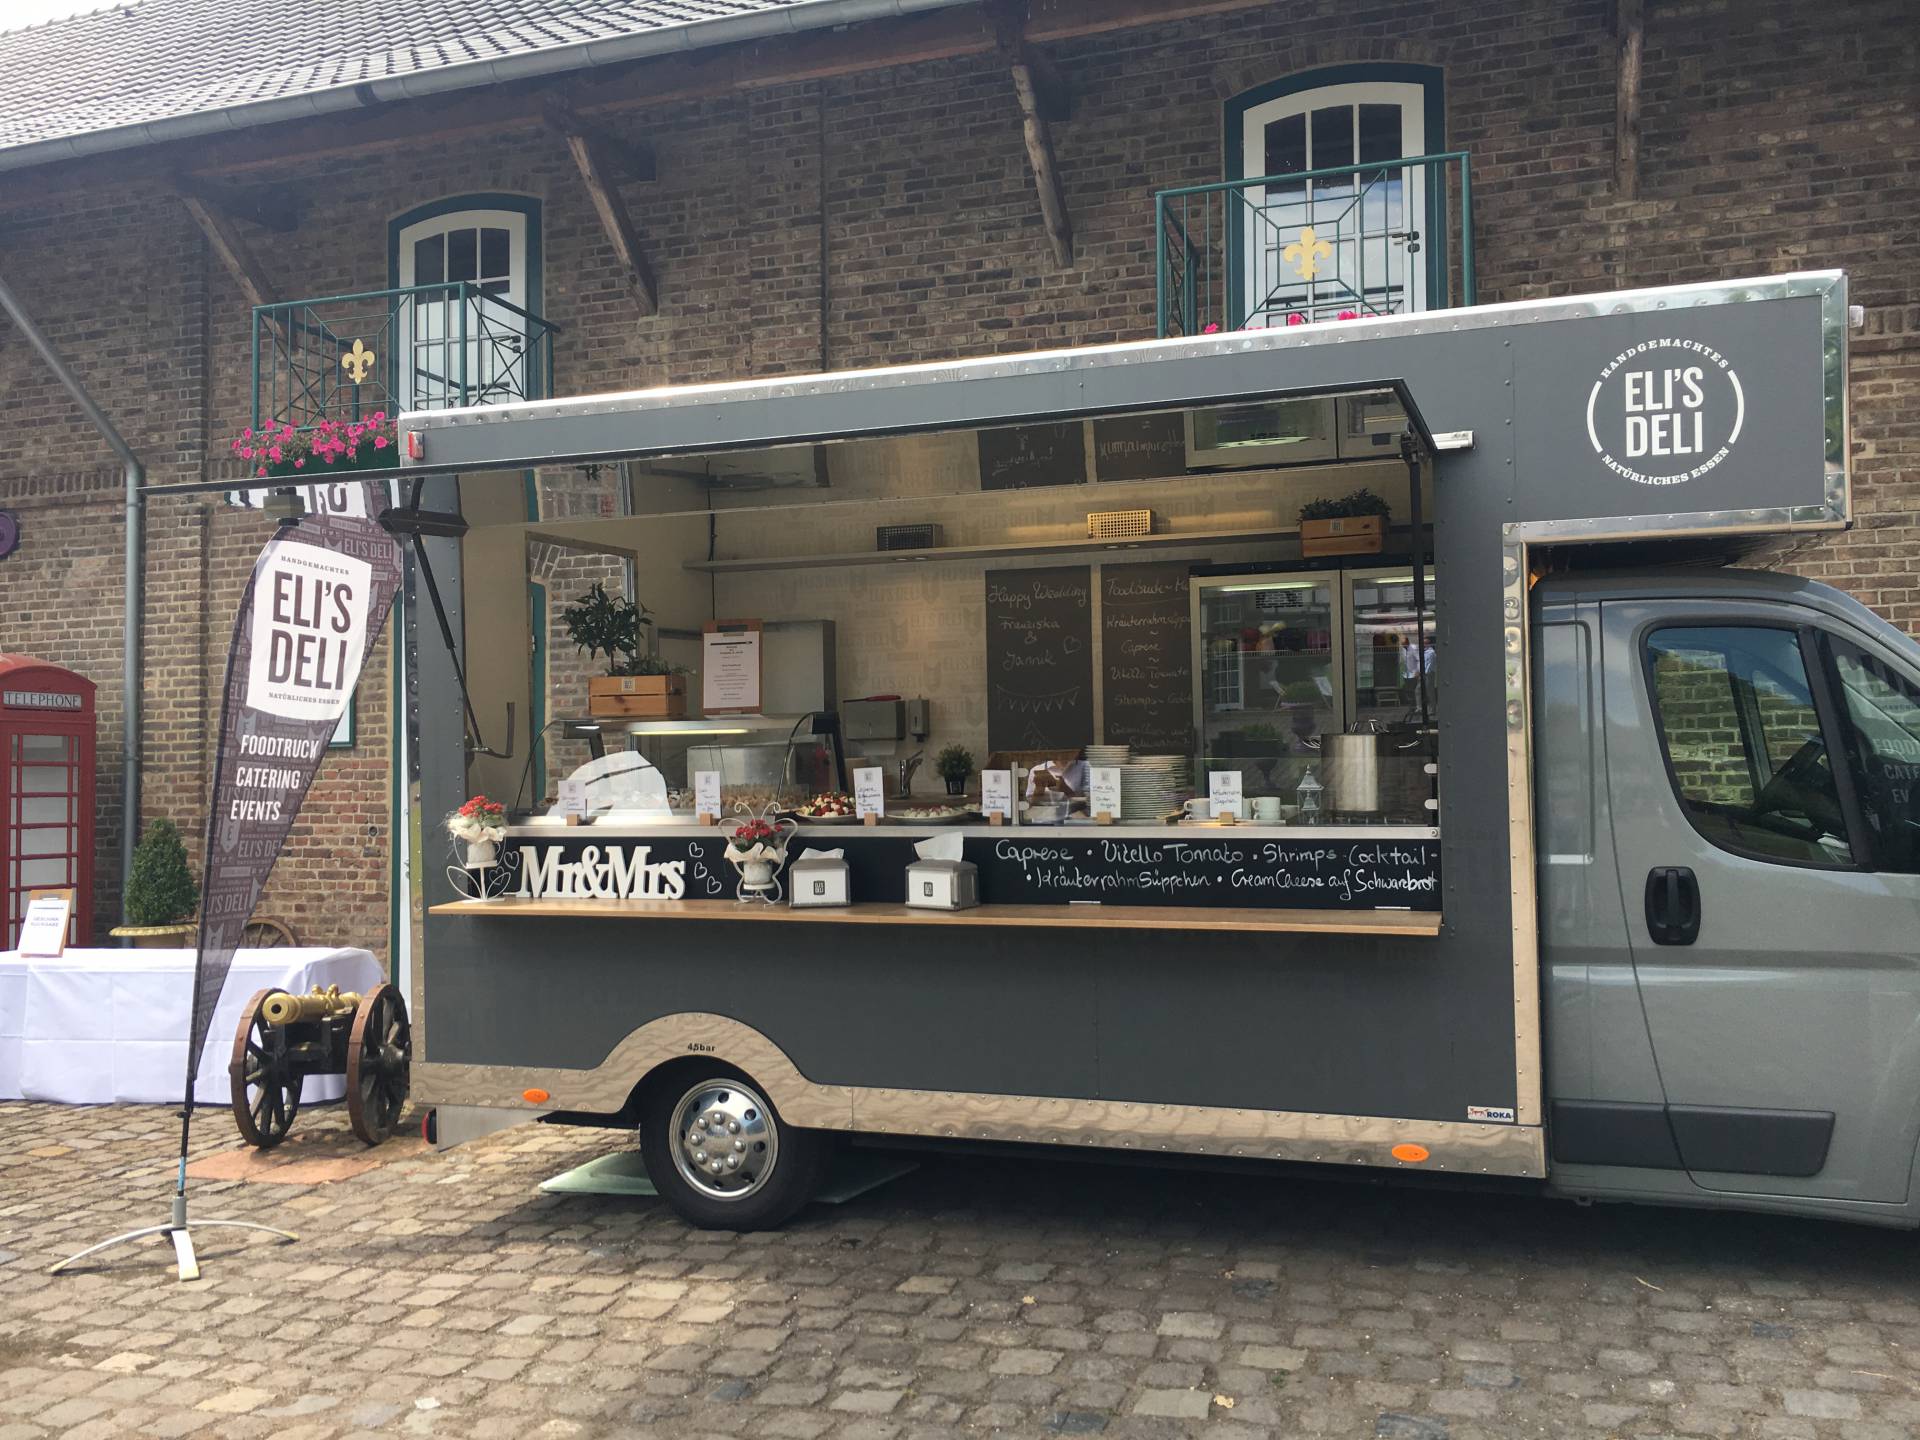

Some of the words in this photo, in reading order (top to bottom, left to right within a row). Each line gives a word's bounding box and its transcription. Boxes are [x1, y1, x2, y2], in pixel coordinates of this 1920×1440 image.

[1600, 338, 1729, 378] HANDGEMACHTES
[1625, 366, 1704, 413] ELI'S
[1625, 411, 1703, 458] DELI
[1601, 453, 1690, 486] NATÜRLICHES
[1690, 446, 1730, 479] ESSEN
[281, 555, 350, 576] HANDGEMACHTES
[370, 542, 393, 560] DELI
[272, 570, 353, 634] ELI'S
[987, 583, 1032, 610] Happy
[1032, 581, 1088, 608] Wedding
[267, 628, 348, 690] DELI
[5, 692, 79, 708] TELEPHONE
[268, 691, 317, 705] NATÜRLICHES
[318, 697, 340, 706] ESSEN
[240, 734, 320, 761] FOODTRUCK
[235, 766, 301, 790] CATERING
[230, 799, 282, 822] EVENTS
[995, 839, 1074, 870] Caprese
[1100, 840, 1163, 865] Vitello
[1163, 842, 1244, 865] Tonnato
[1262, 843, 1338, 872] Shrimps
[516, 845, 686, 900] Mr&Mrs
[1328, 868, 1351, 901] auf
[1486, 1111, 1512, 1119] ROKA
